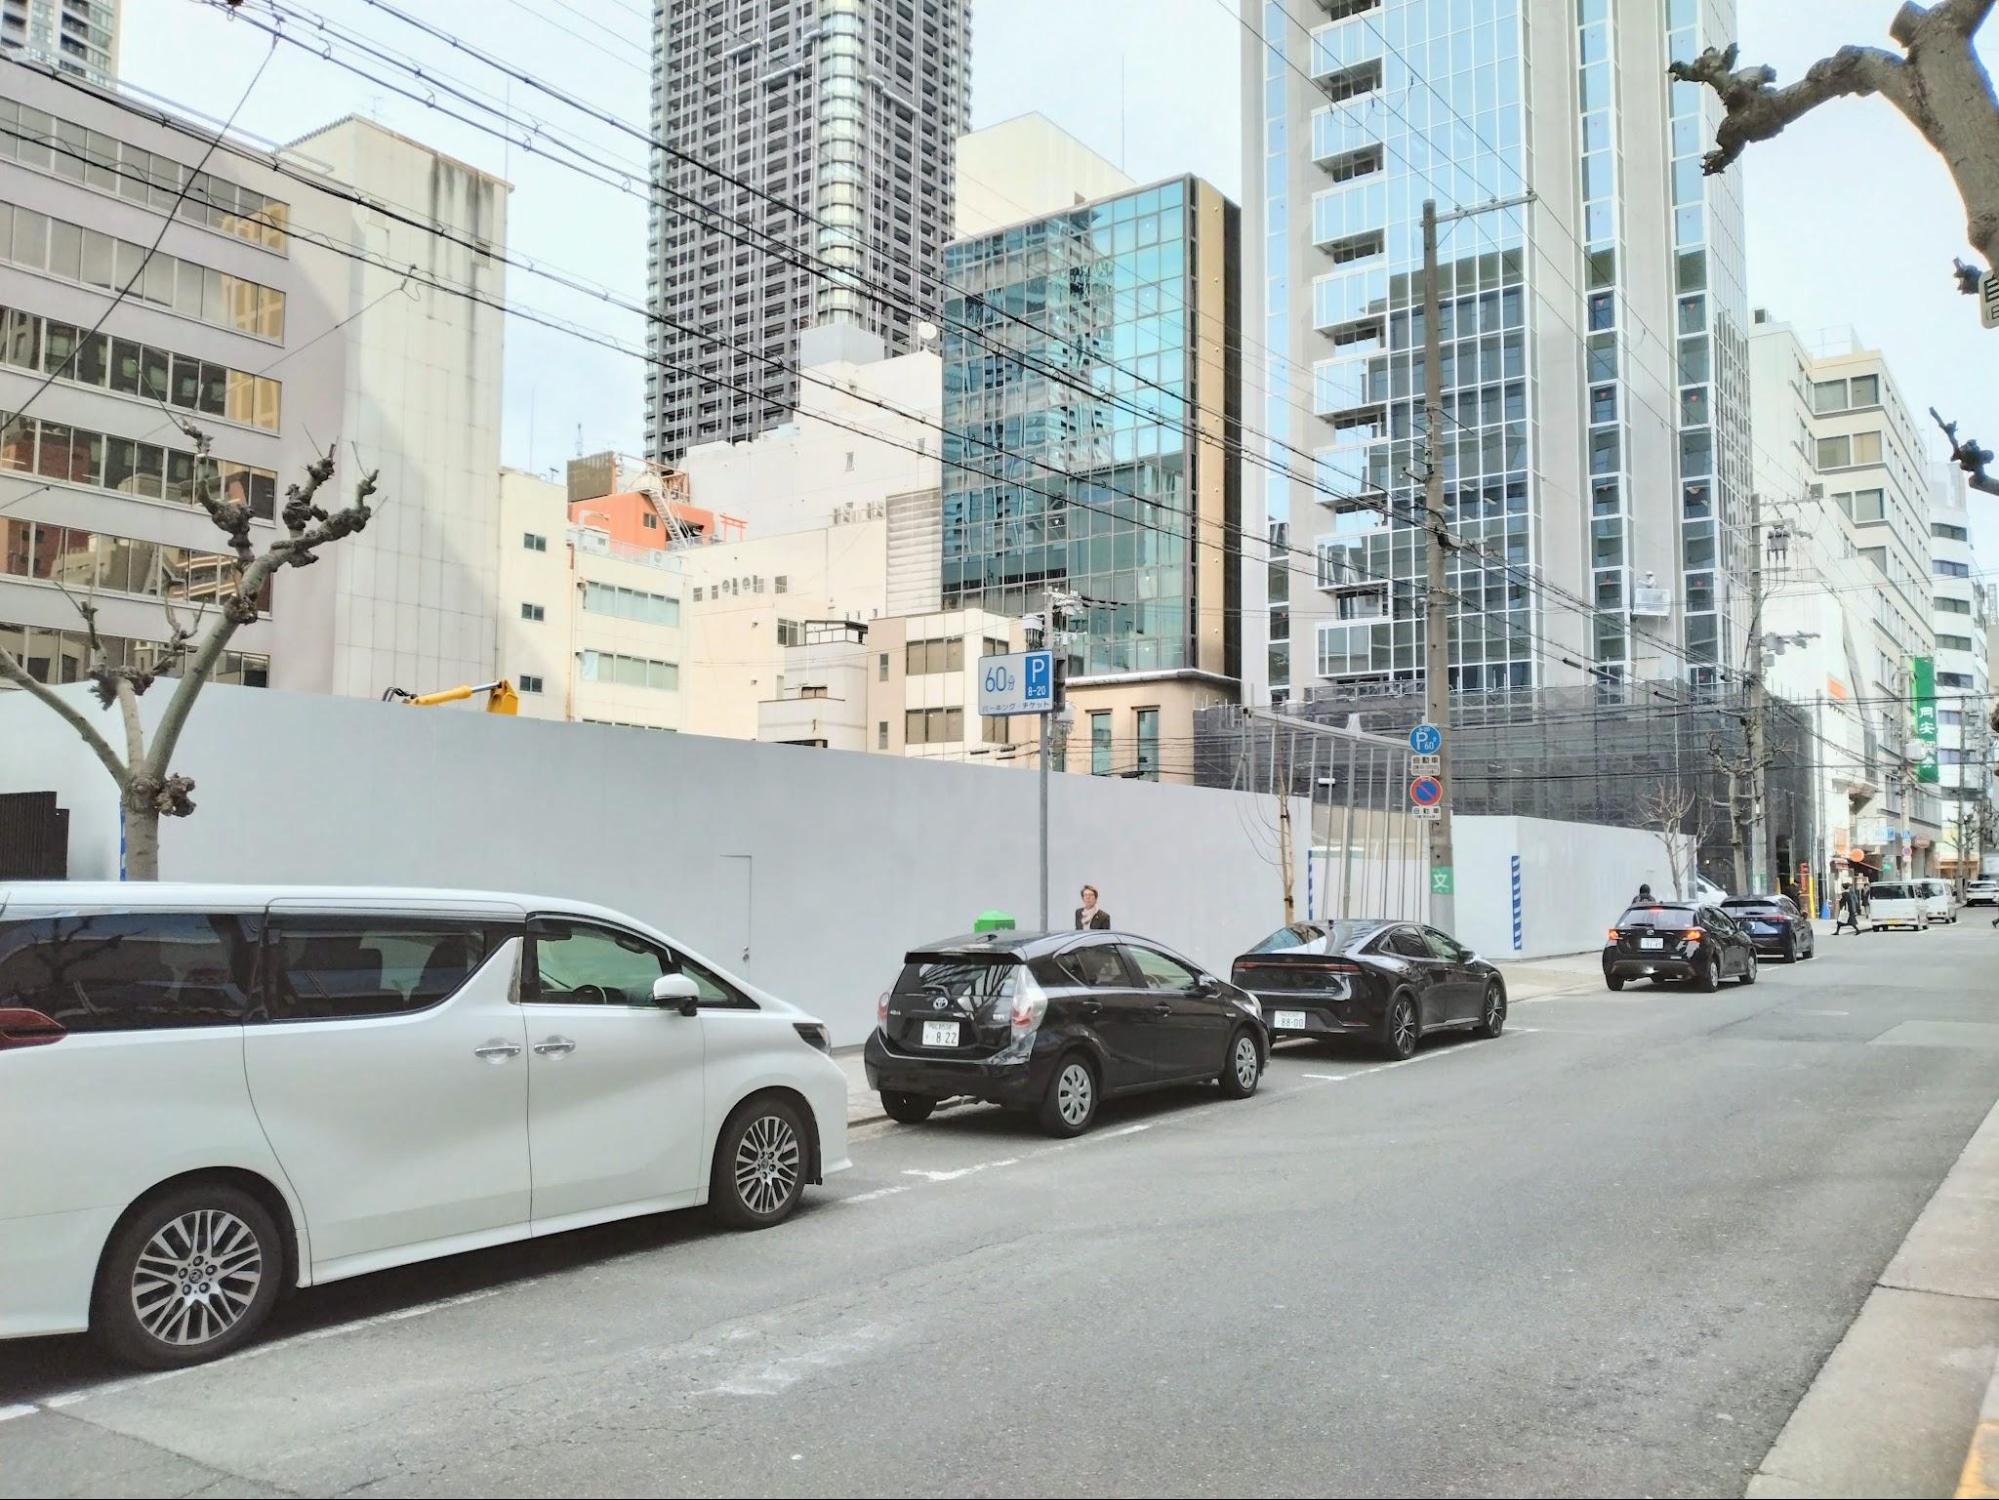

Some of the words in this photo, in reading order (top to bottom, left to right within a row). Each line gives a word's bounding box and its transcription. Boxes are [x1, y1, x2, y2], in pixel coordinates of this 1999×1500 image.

[985, 666, 1015, 692] 60分
[1032, 658, 1045, 683] P
[1027, 685, 1047, 697] 8-20
[1416, 732, 1429, 751] P
